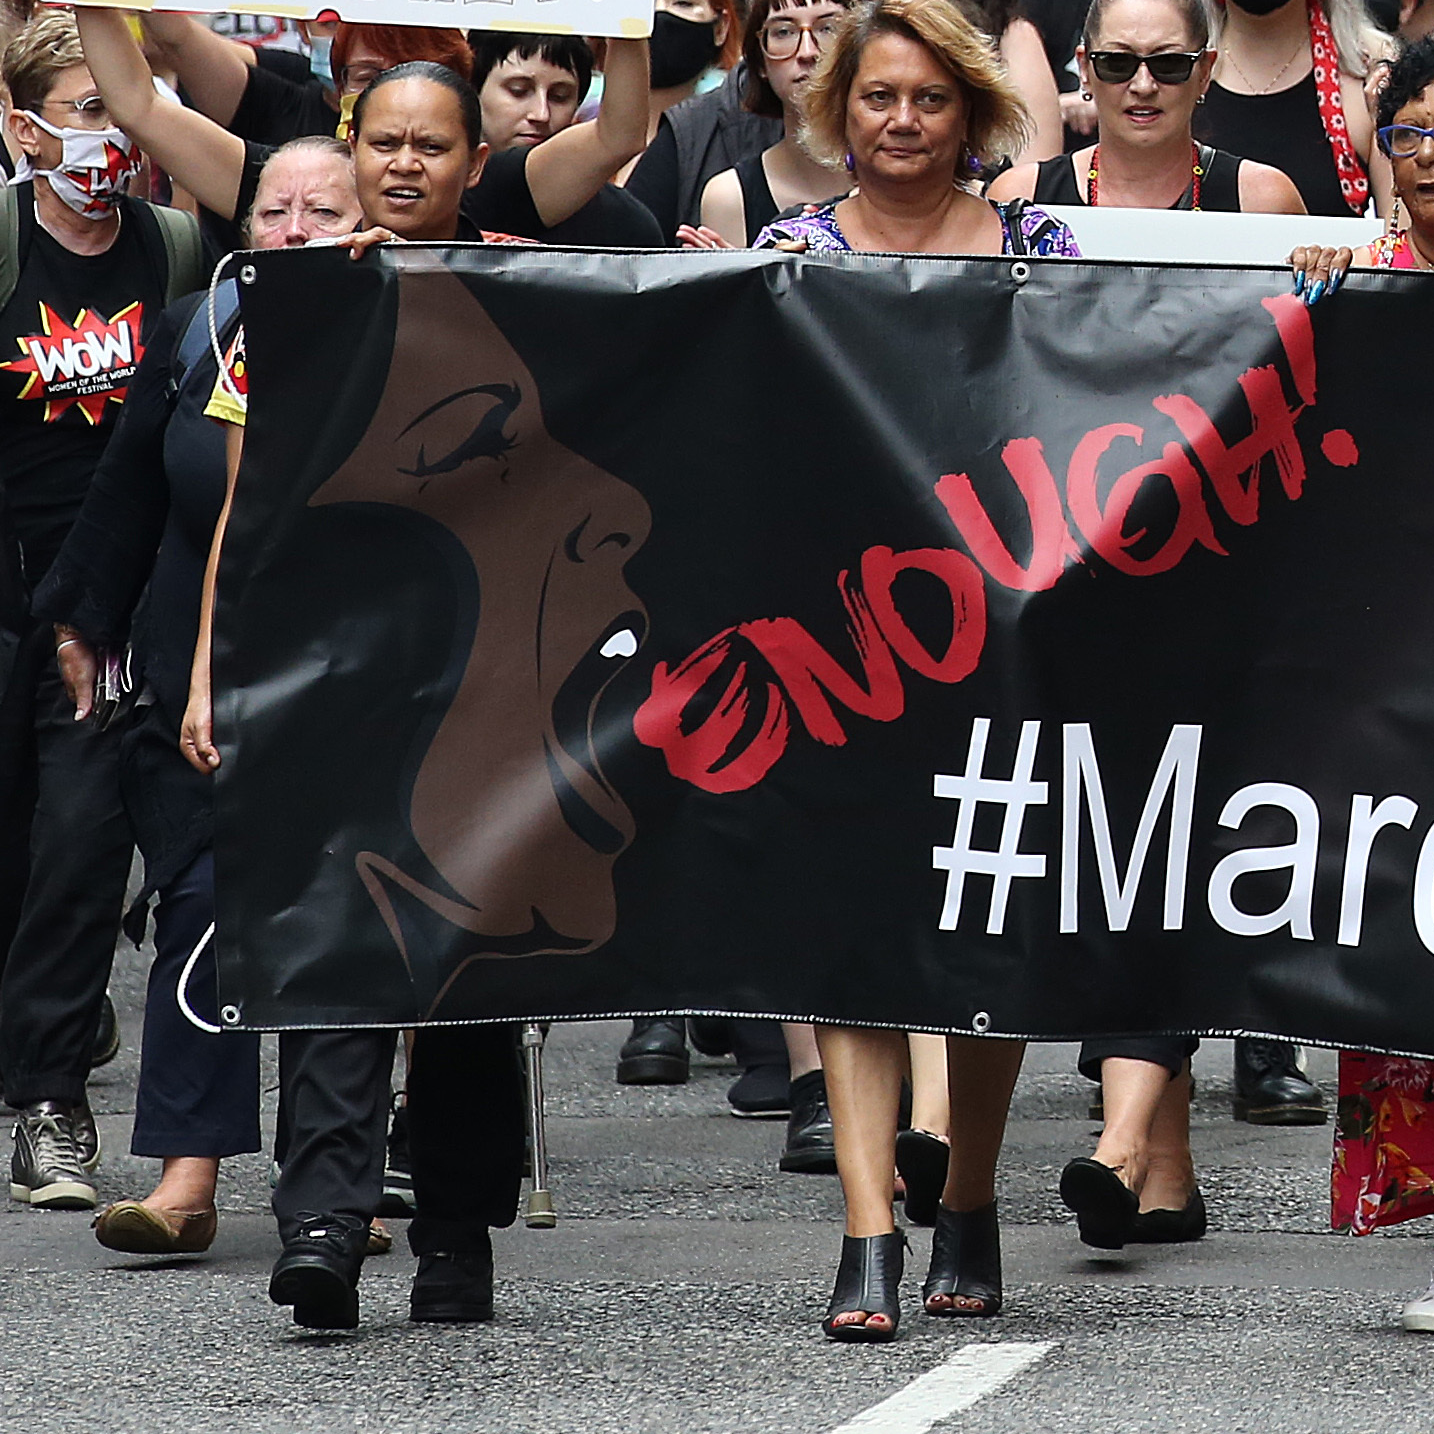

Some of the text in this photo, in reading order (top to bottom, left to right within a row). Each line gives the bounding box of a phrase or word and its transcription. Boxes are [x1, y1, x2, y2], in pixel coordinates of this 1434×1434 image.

[29, 320, 132, 382] WOW
[48, 367, 136, 392] WOMEN OF THE WORLD
[77, 382, 114, 395] FESTIVAL
[634, 294, 1360, 794] ENOUGH!
